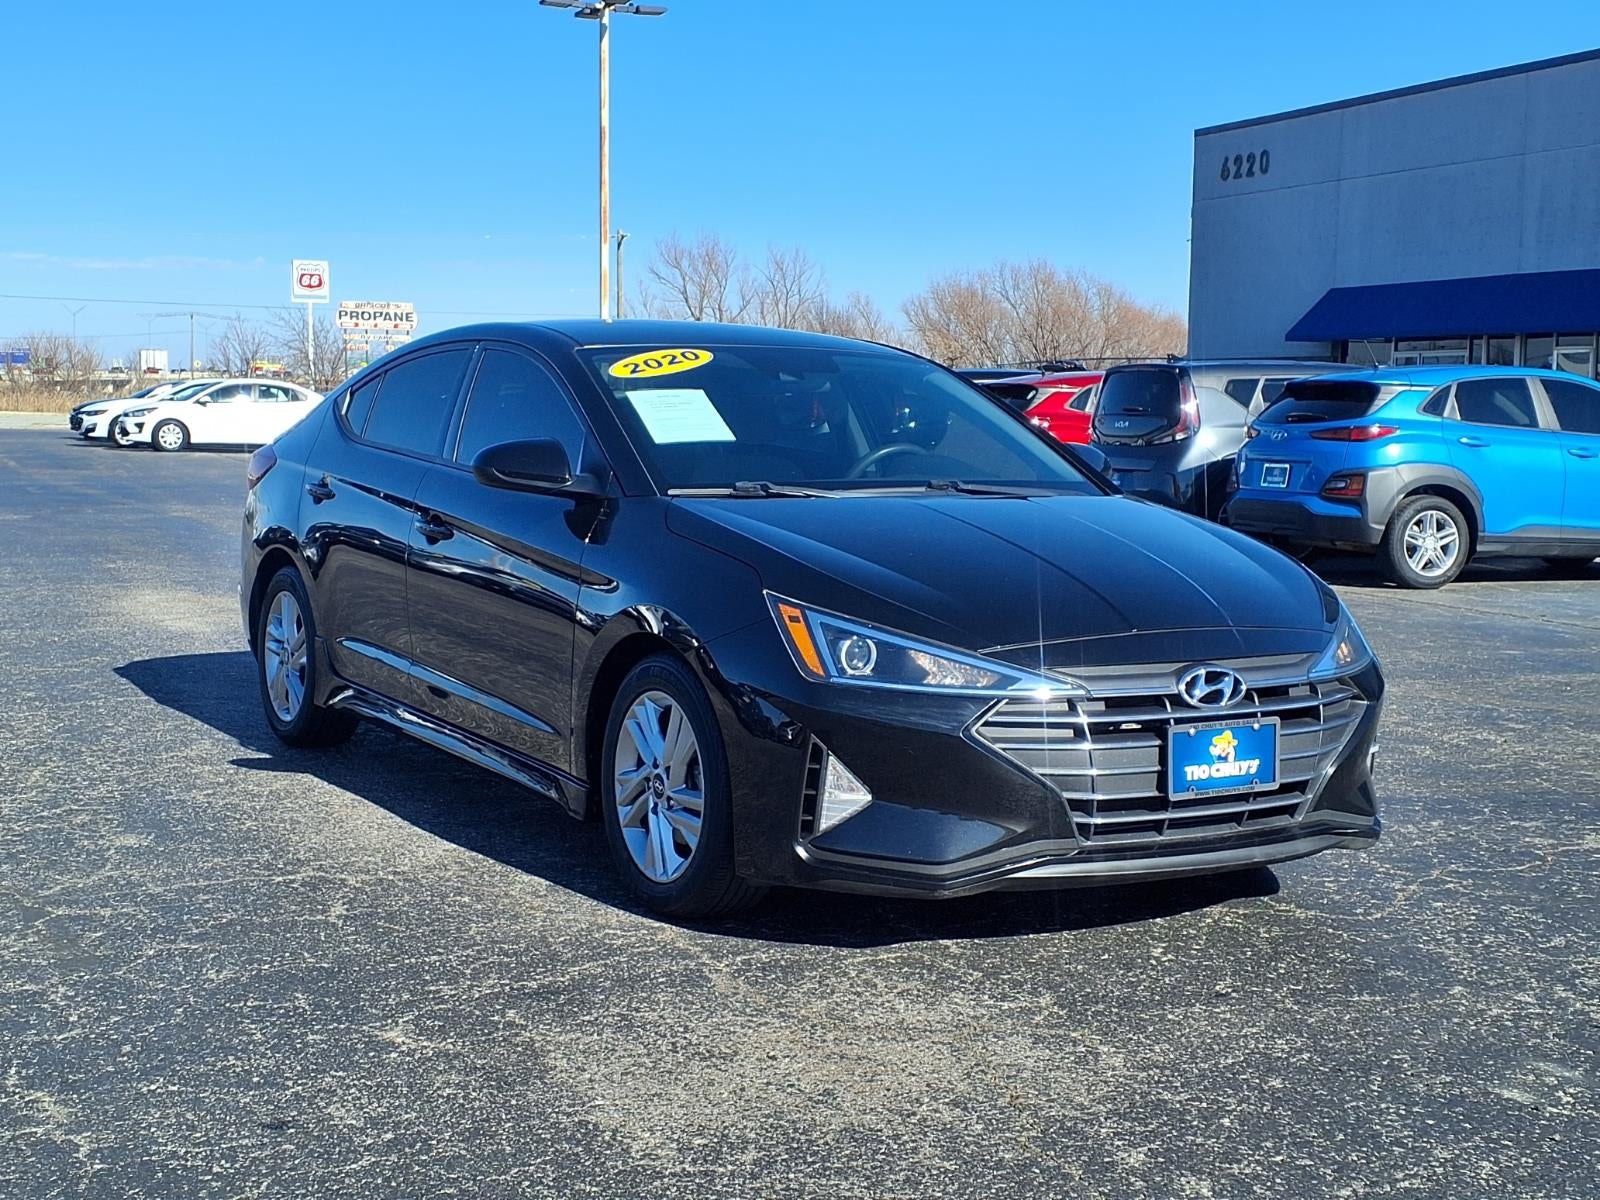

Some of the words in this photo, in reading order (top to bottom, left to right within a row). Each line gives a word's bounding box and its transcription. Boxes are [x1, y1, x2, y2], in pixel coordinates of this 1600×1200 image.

[1220, 149, 1270, 181] 6220
[301, 274, 320, 287] 66
[338, 310, 414, 322] PROPANE
[623, 351, 700, 374] 2020
[1184, 764, 1210, 781] TIO
